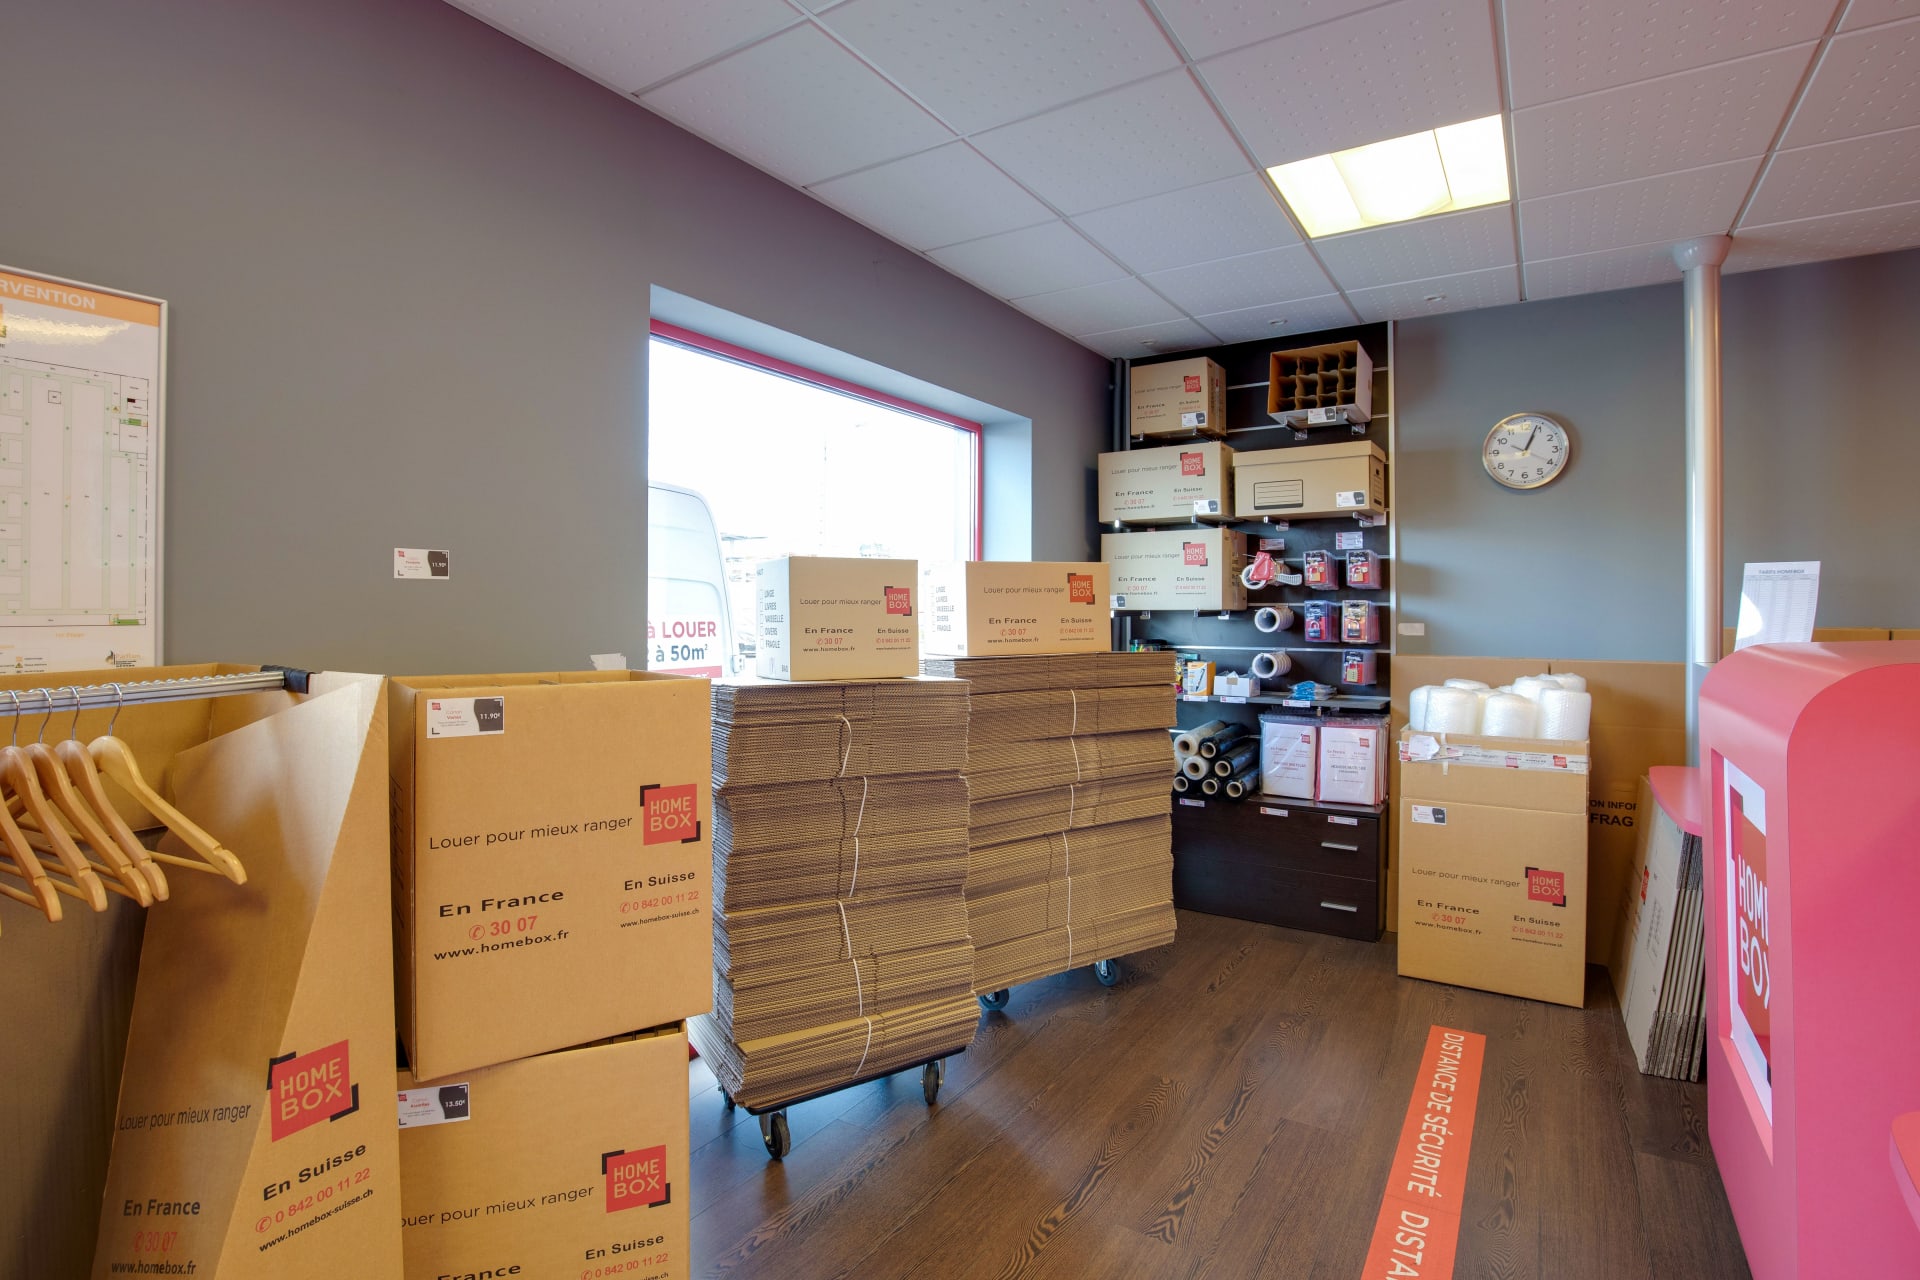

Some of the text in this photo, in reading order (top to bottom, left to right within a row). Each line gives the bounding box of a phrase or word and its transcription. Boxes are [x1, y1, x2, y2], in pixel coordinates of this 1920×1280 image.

[1546, 434, 1554, 442] 2
[1551, 445, 1559, 453] 3
[1184, 464, 1202, 472] BOX
[1497, 462, 1505, 470] 8
[1508, 469, 1514, 477] 7
[983, 586, 1003, 594] Louer
[1005, 587, 1021, 595] pour
[1072, 580, 1091, 589] HOME
[1072, 589, 1092, 597] BOX
[889, 601, 908, 609] BOX
[662, 621, 717, 638] LOUER
[1008, 628, 1026, 636] 30 07
[824, 637, 843, 645] 30 07
[655, 644, 665, 662] à
[649, 796, 692, 816] HOME
[650, 812, 692, 833] BOX
[429, 816, 633, 850] Louer pour mieux ranger
[624, 871, 695, 891] En Suisse
[1412, 867, 1520, 888] Louer pour mieux ranger
[1532, 875, 1561, 888] HOME
[632, 890, 700, 912] 0 842 00 11 22
[1532, 886, 1561, 897] BOX
[438, 890, 565, 918] En France
[1417, 899, 1480, 915] En France
[490, 915, 539, 937] 30 07
[620, 907, 700, 929] www.homebox-suisse.ch
[1414, 920, 1482, 936] www.homebox.fr
[1441, 914, 1466, 925] 30 07
[1513, 914, 1561, 928] En Suisse
[433, 929, 569, 961] www.homebox.fr
[280, 1057, 342, 1099] HOME
[281, 1079, 343, 1121] BOX
[120, 1103, 251, 1132] Louer pour mieux ranger
[1386, 1032, 1465, 1280] DISTANCE DE SÉCURITÉ DISTA
[263, 1144, 366, 1201] En Suisse
[613, 1159, 660, 1183] HOME
[275, 1168, 370, 1223] 0 842 00 11 22
[614, 1175, 660, 1199] BOX
[123, 1199, 200, 1216] En France
[441, 1206, 480, 1224] pour
[486, 1198, 535, 1215] mieux
[541, 1185, 595, 1206] ranger
[259, 1188, 373, 1252] www.homebox-suisse.ch
[144, 1231, 177, 1251] 30 07
[585, 1235, 664, 1260] En Suisse
[111, 1260, 196, 1275] www.homebox.fr
[595, 1252, 668, 1278] 0 842 00 11 22
